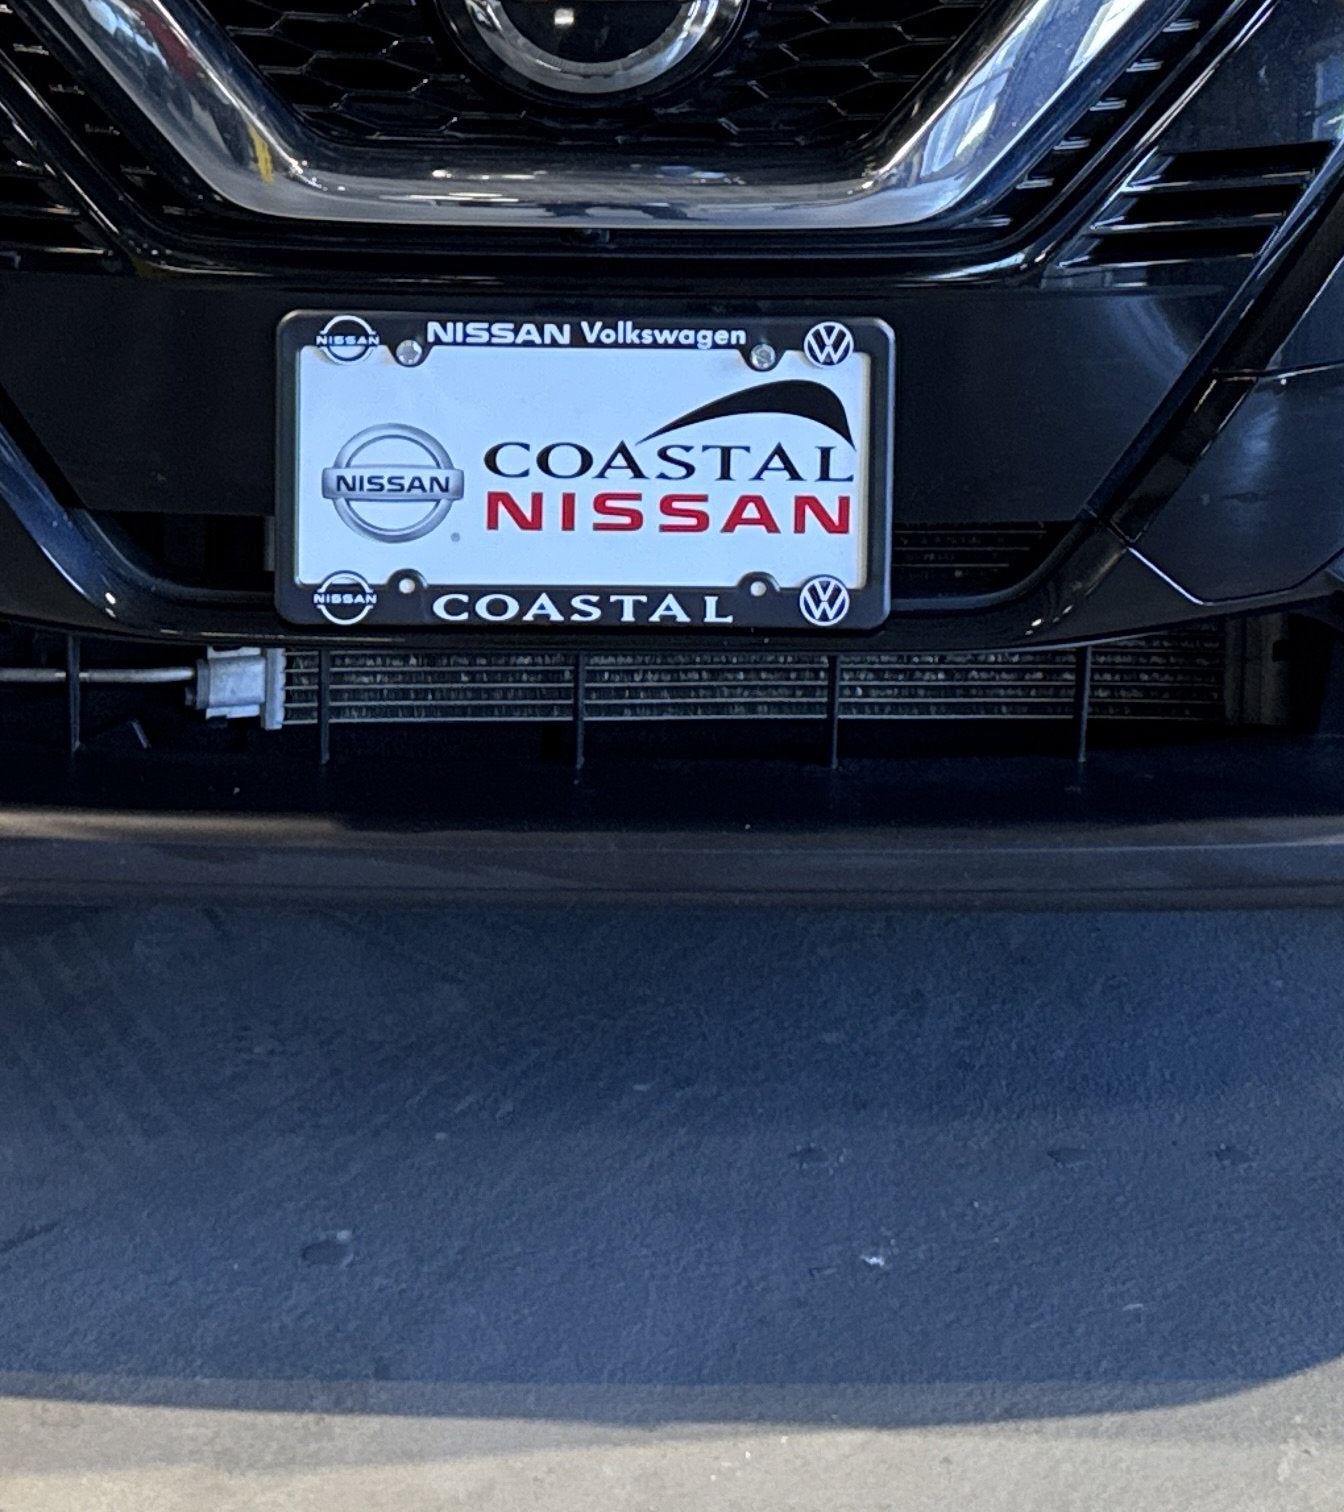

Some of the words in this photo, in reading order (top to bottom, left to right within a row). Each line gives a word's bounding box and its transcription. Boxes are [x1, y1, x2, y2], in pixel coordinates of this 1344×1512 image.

[316, 335, 379, 346] NISSAN
[427, 321, 571, 345] NISSAN
[580, 320, 746, 350] Volkswagen
[483, 440, 855, 483] COASTAL
[335, 473, 451, 494] NISSAN
[485, 491, 851, 534] NISSAN
[313, 593, 377, 605] NISSAN
[432, 592, 734, 624] COASTAL
